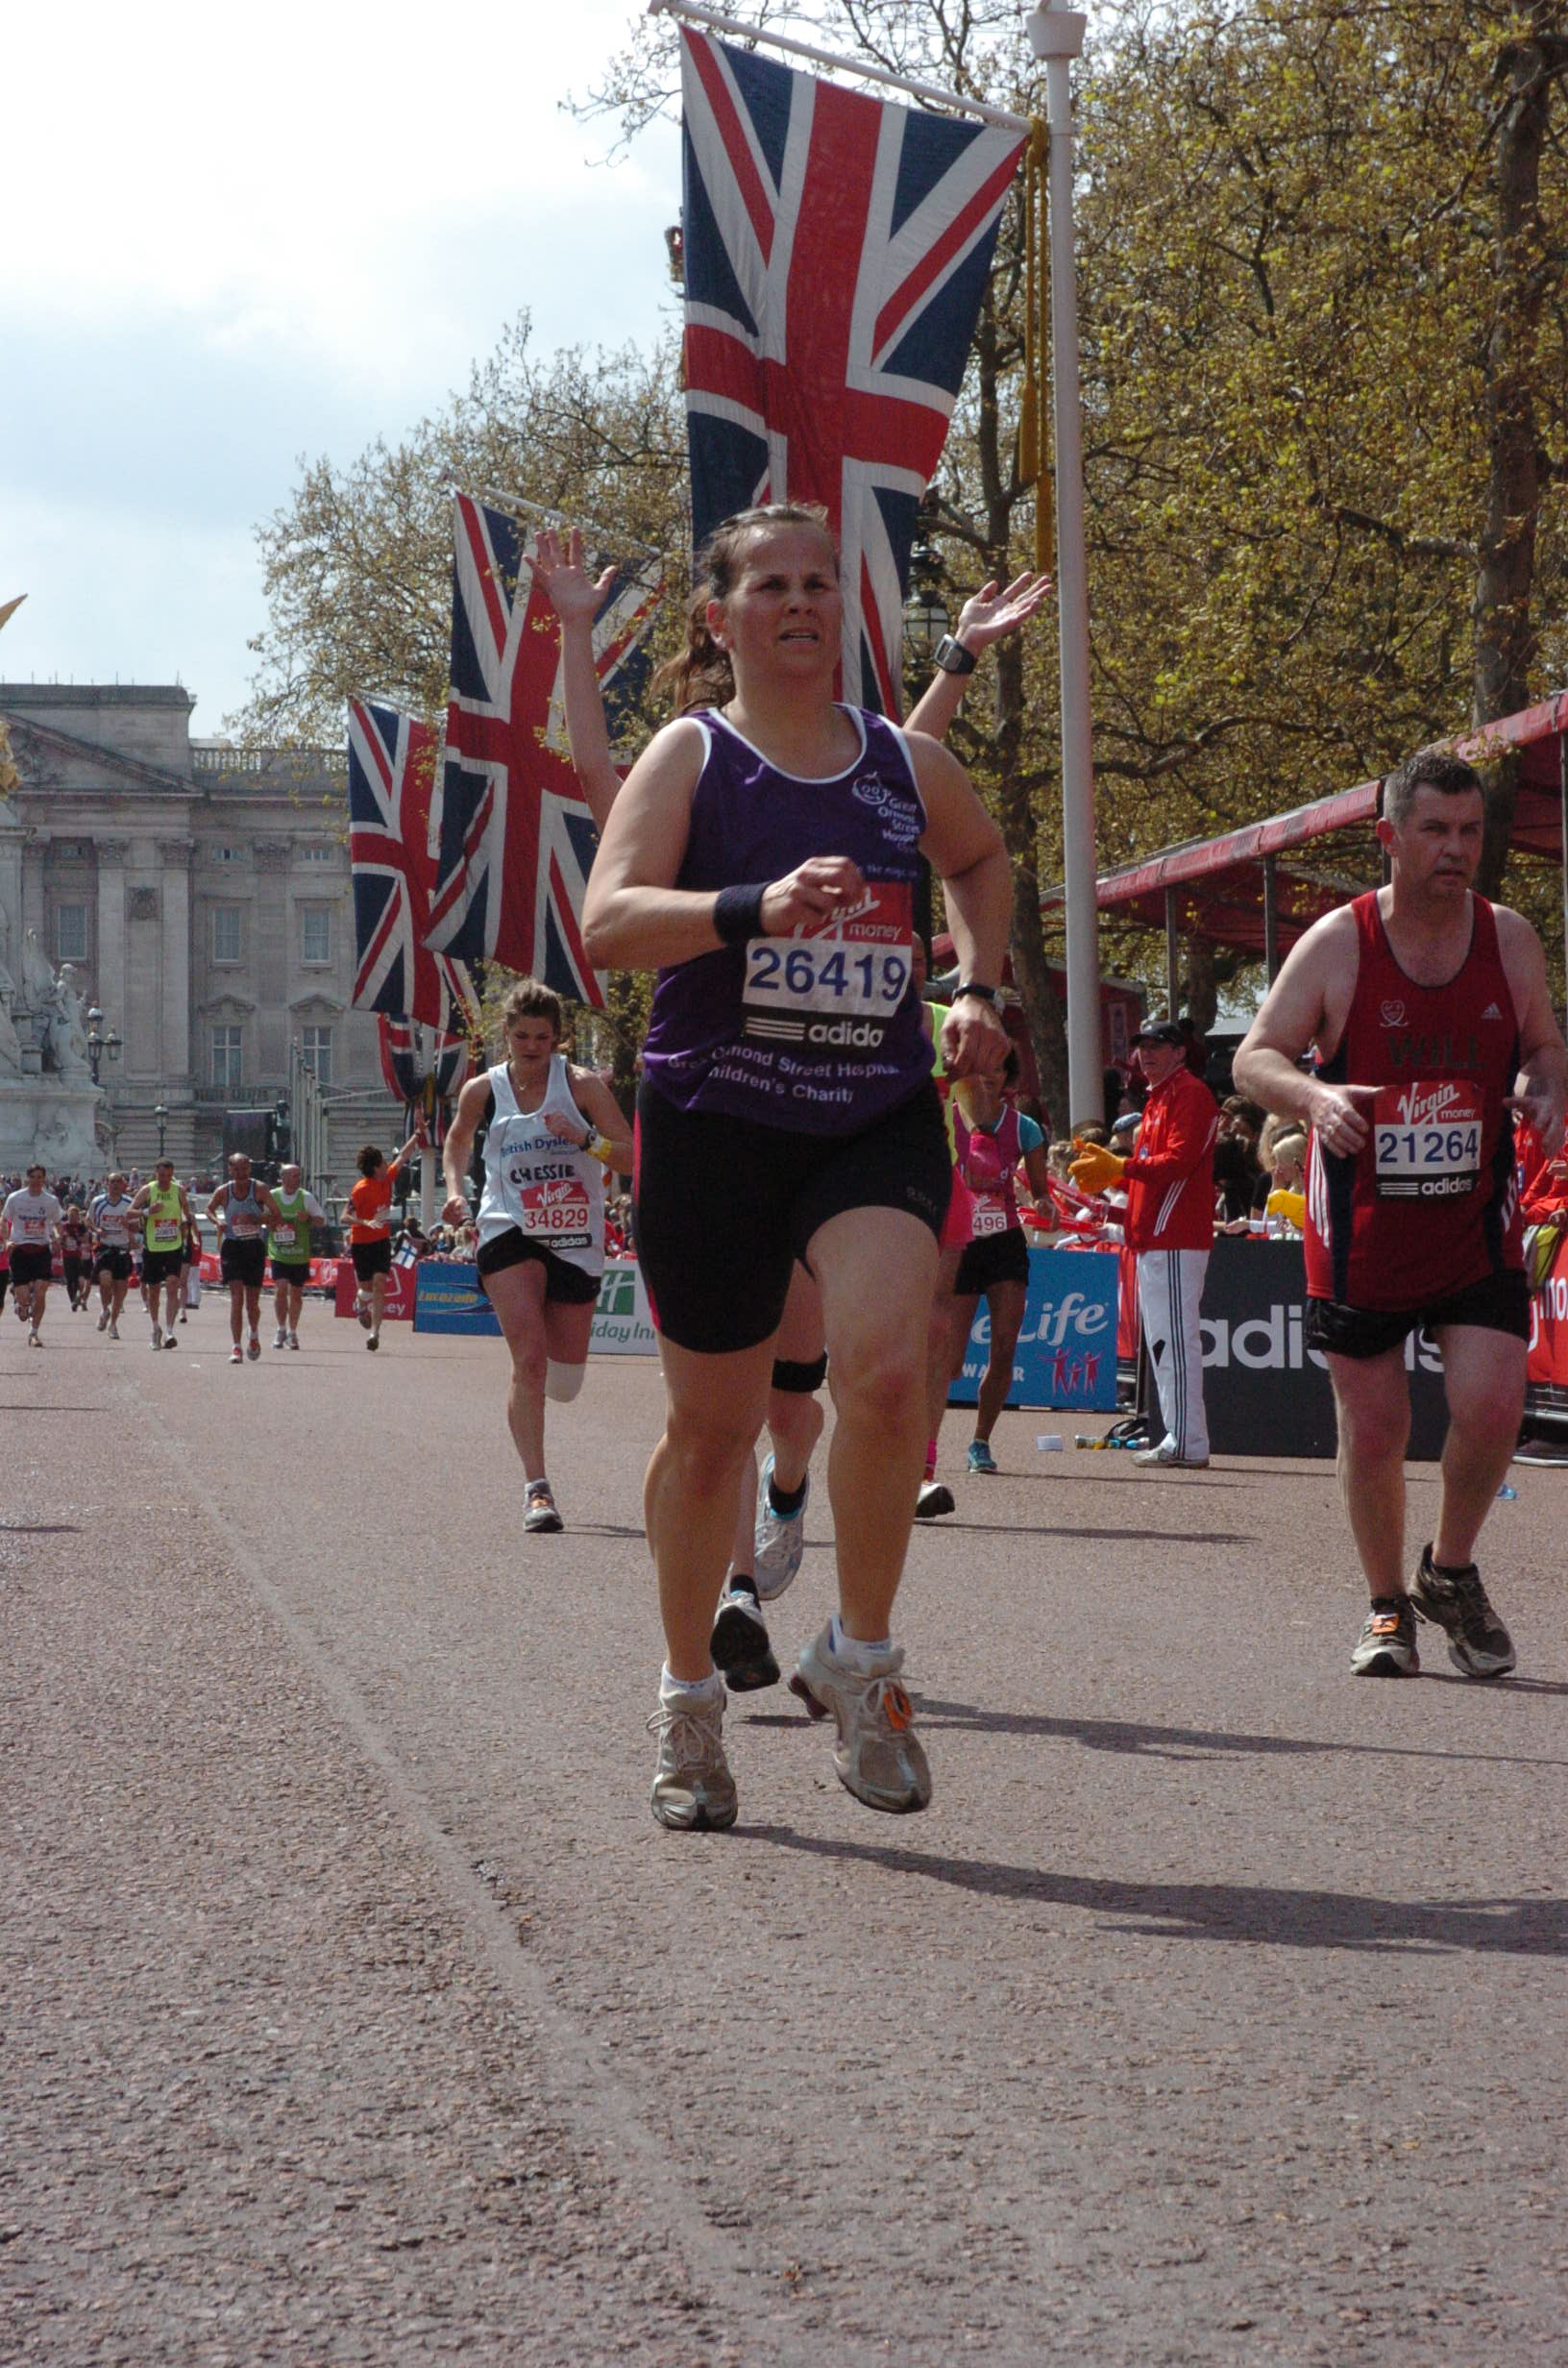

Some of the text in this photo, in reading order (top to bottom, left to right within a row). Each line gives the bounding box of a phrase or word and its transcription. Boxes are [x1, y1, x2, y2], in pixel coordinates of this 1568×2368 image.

[849, 922, 902, 943] money
[748, 947, 906, 1001] 26419
[808, 1021, 884, 1047] adida
[708, 1064, 785, 1095] hildren's
[1397, 1081, 1460, 1125] Virgin
[534, 1135, 570, 1150] Dysle
[1379, 1128, 1478, 1164] 21264
[510, 1164, 575, 1184] CHESSIE
[1421, 1176, 1473, 1196] adidas
[525, 1208, 588, 1229] 34829
[591, 1320, 631, 1344] iday
